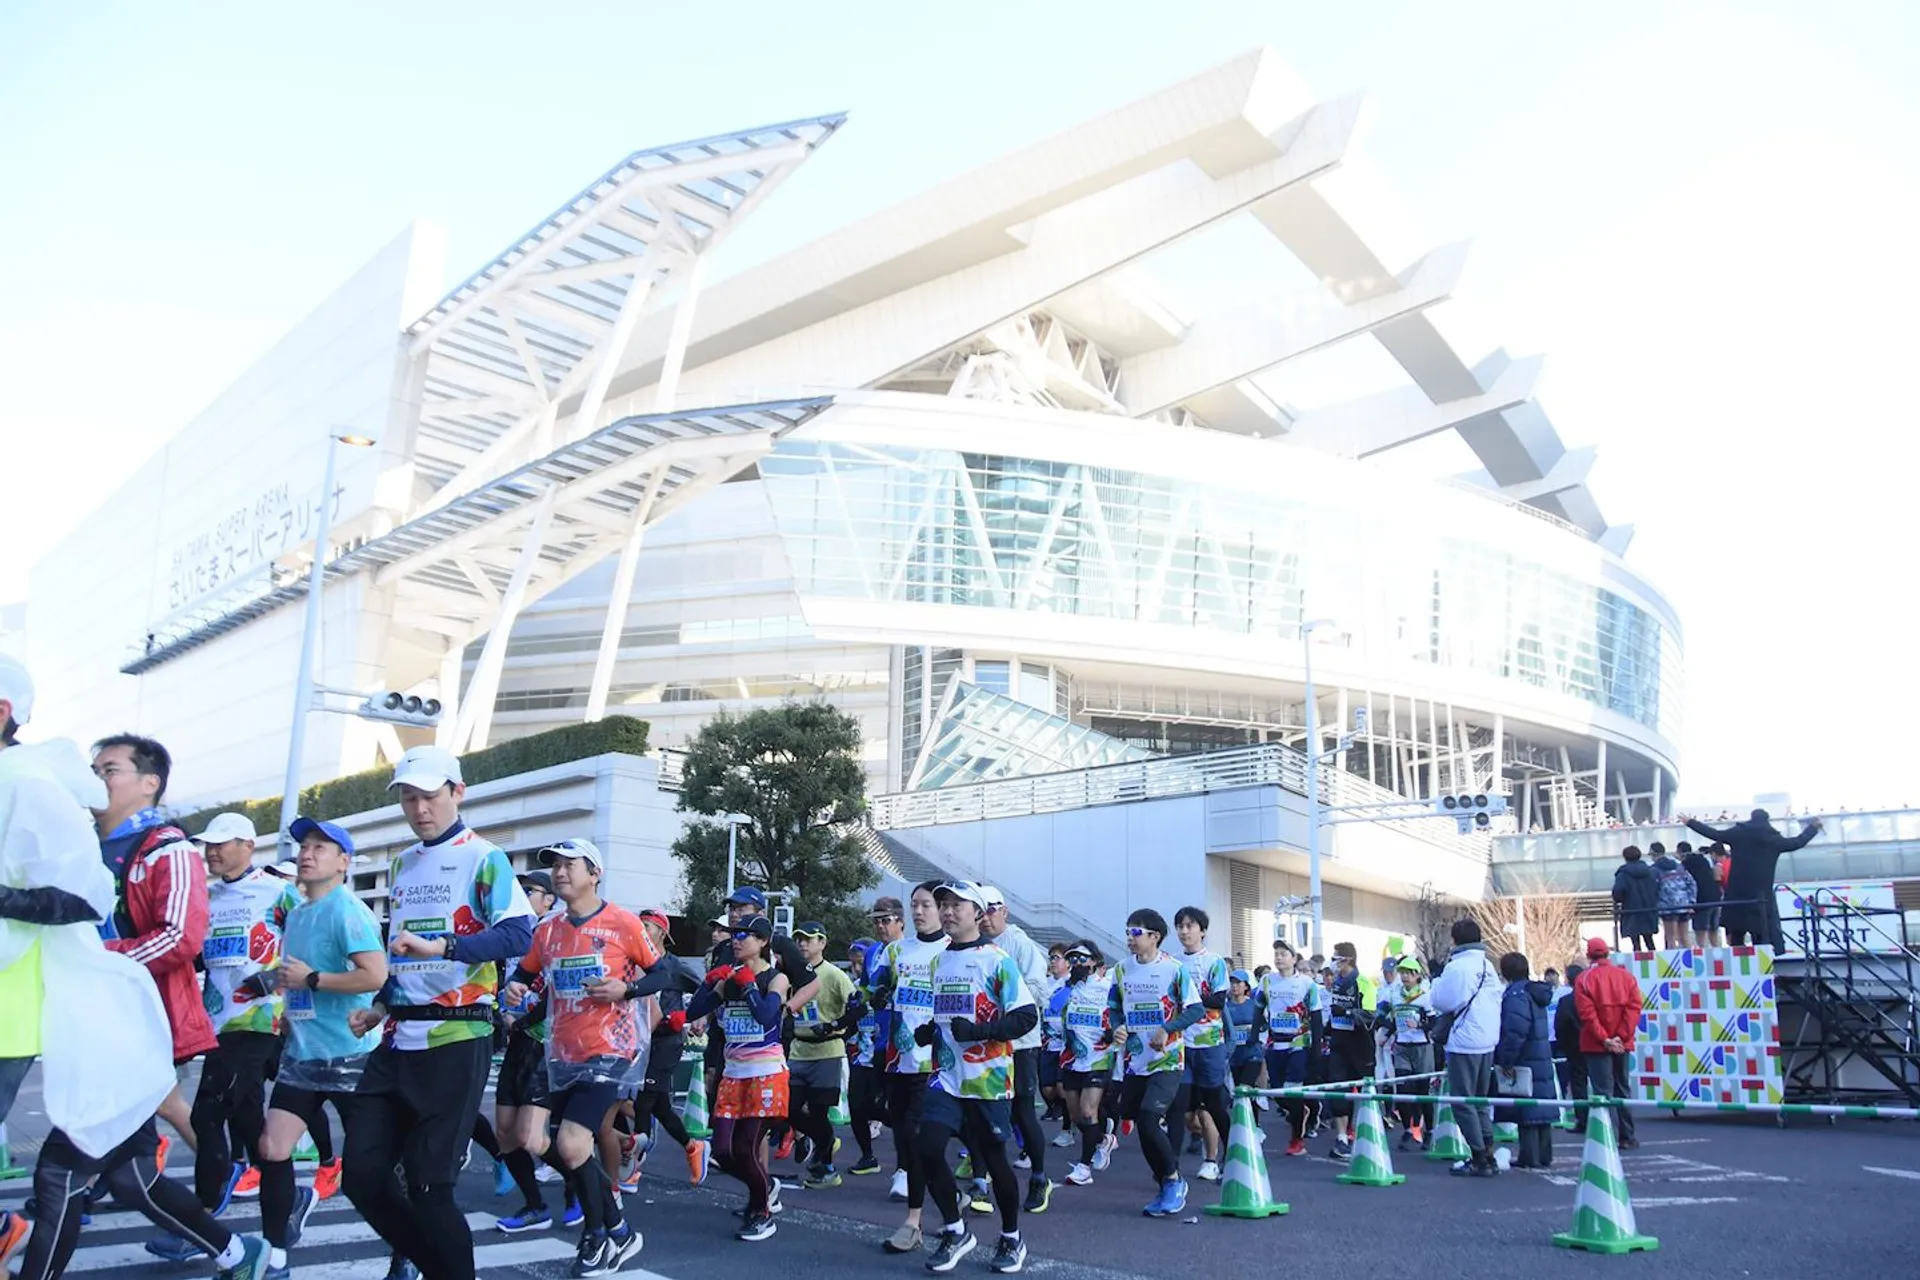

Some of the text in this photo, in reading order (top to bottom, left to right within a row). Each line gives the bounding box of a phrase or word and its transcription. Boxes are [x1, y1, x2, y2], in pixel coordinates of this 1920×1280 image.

[407, 884, 451, 896] SAITAMA
[404, 896, 451, 905] MARATHON
[218, 908, 252, 917] SAITAMA
[897, 987, 934, 1004] E2475
